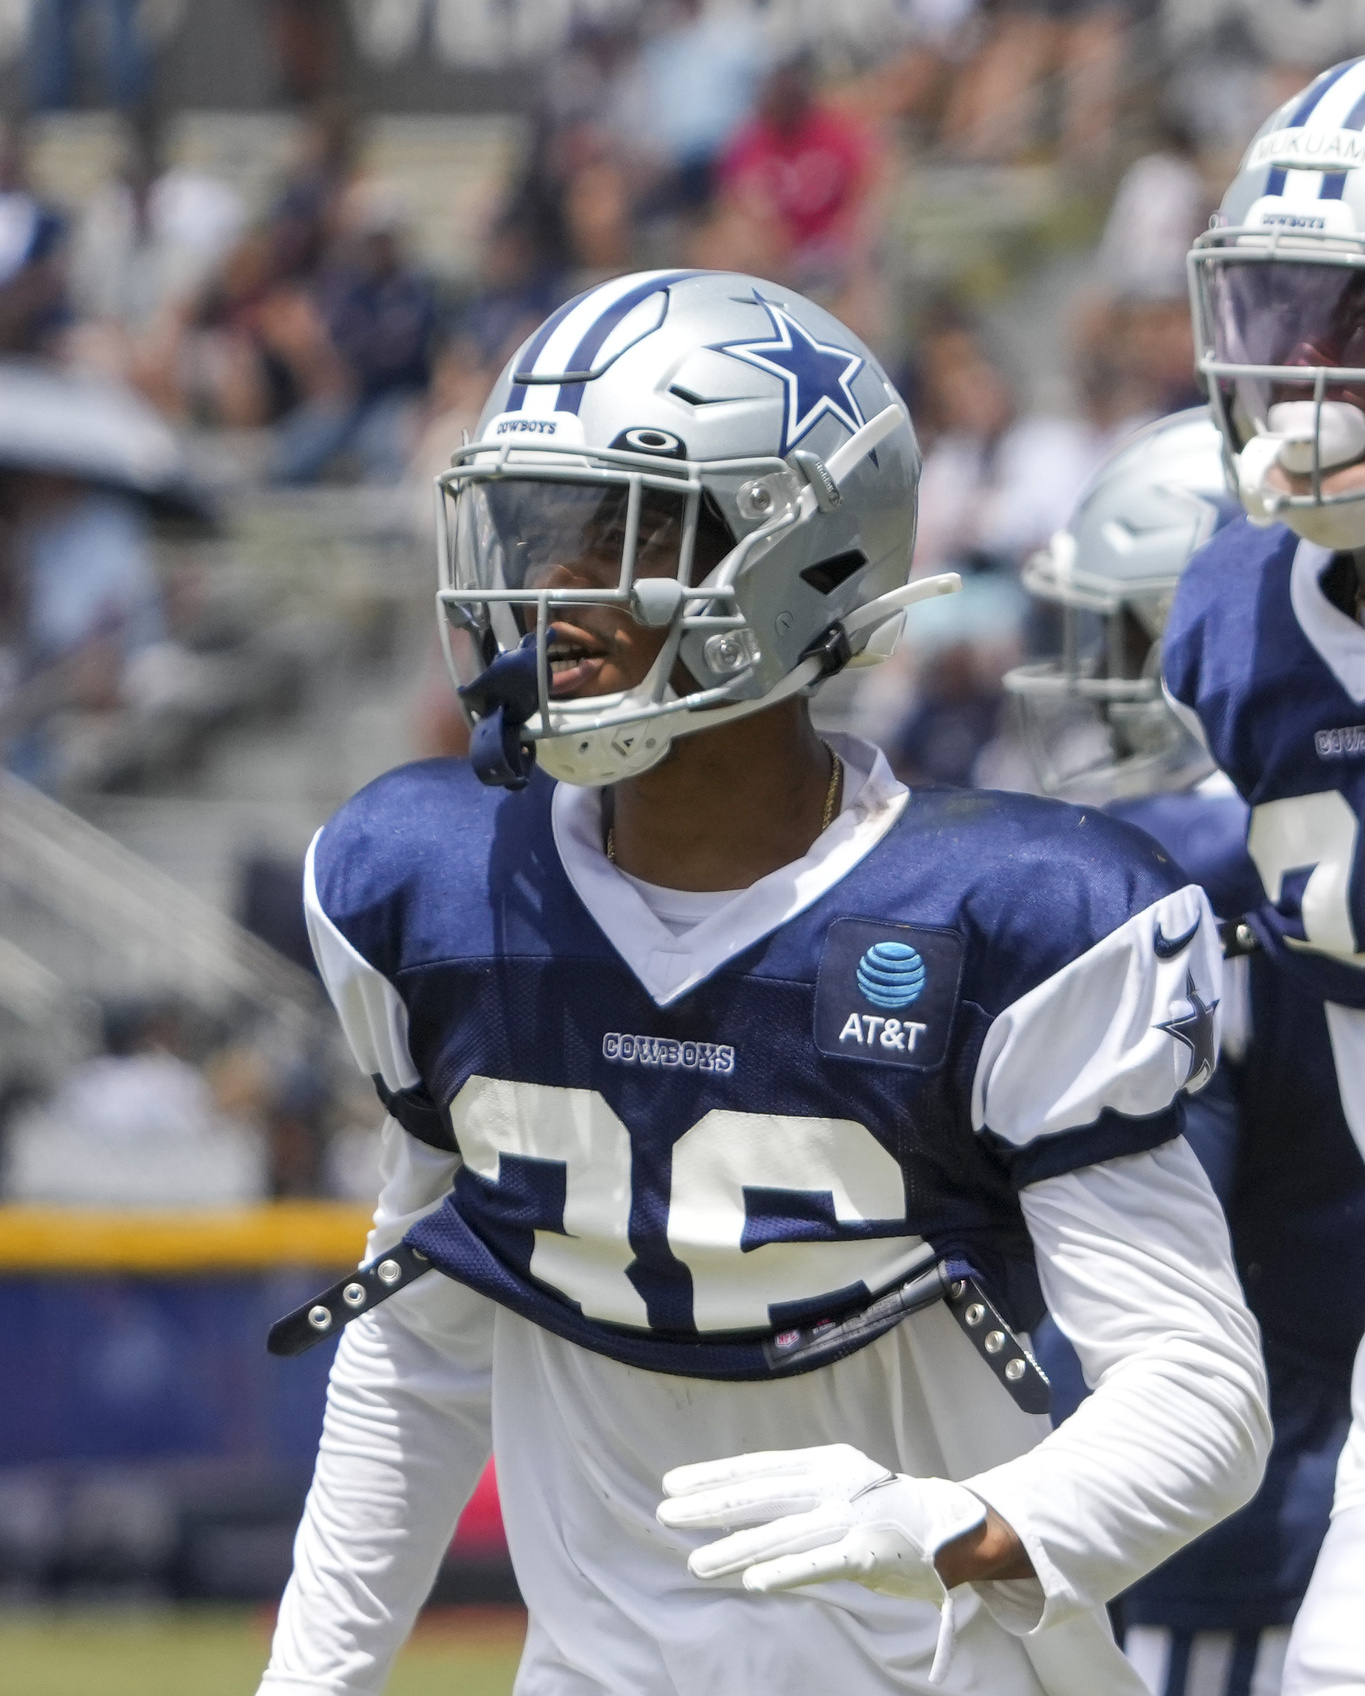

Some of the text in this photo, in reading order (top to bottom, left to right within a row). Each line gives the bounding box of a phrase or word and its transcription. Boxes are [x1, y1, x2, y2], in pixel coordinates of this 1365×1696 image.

[496, 419, 557, 434] COWBOYS
[602, 1032, 736, 1073] COWBOYS
[838, 1013, 927, 1054] AT&T
